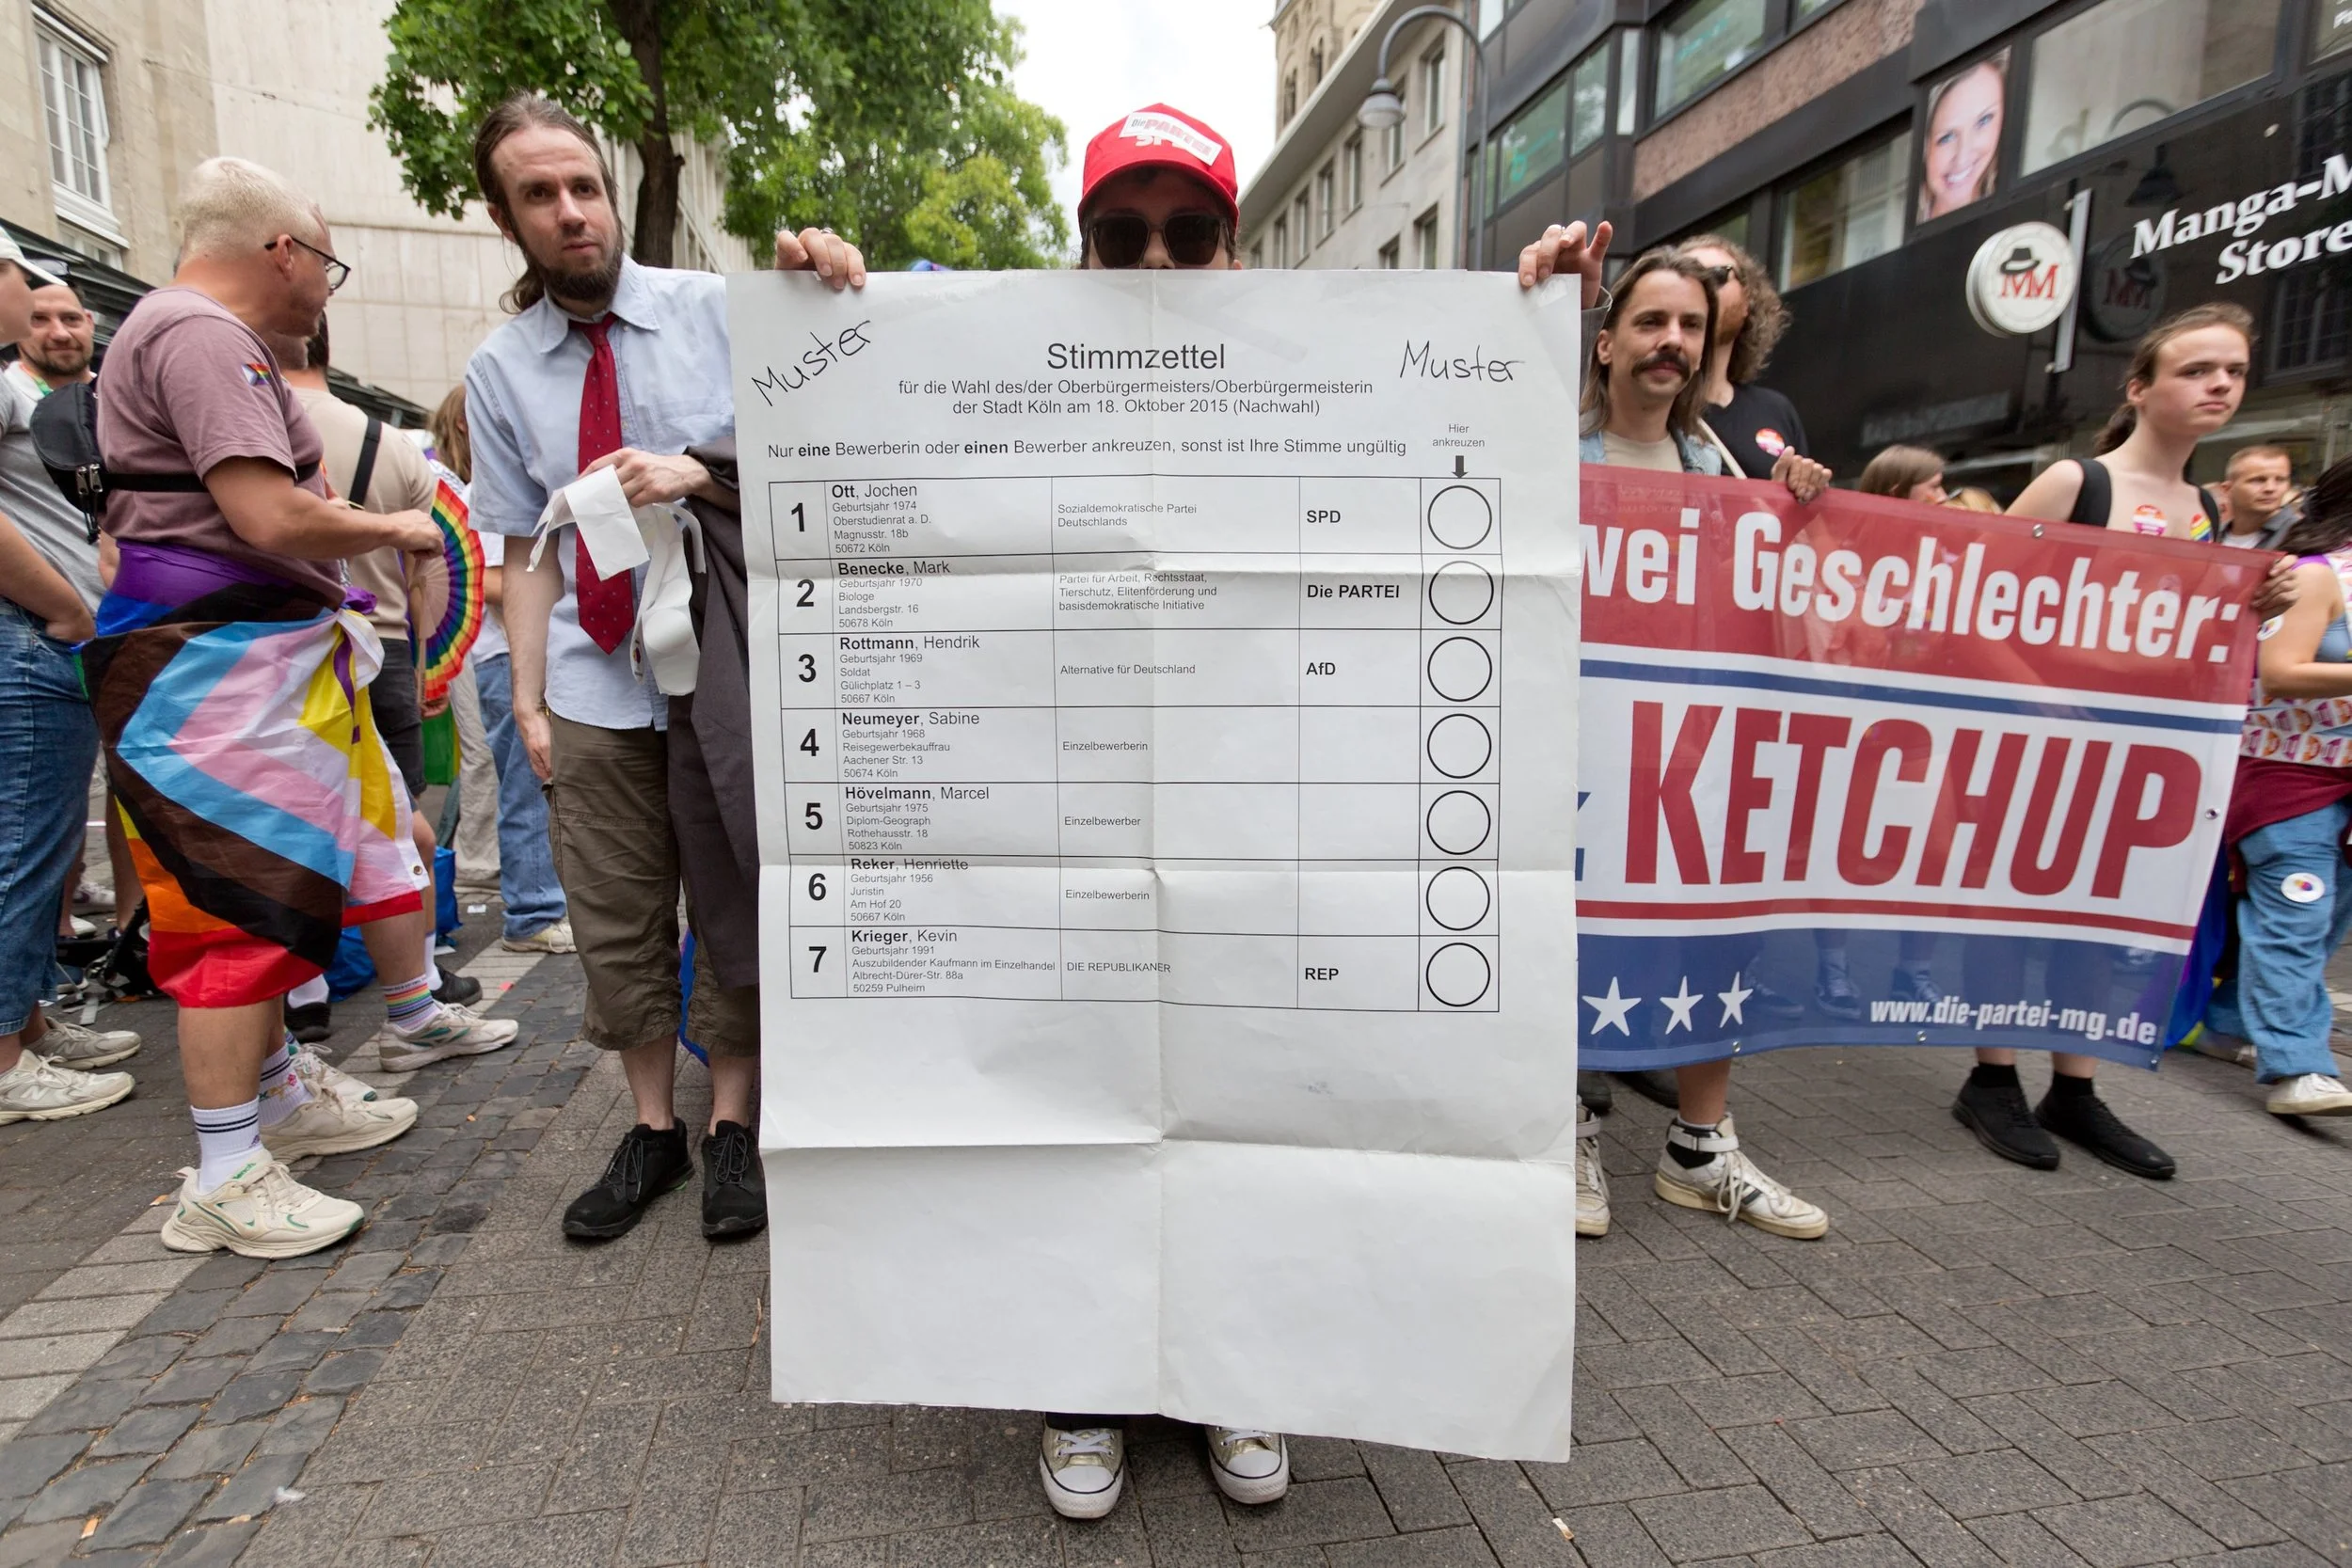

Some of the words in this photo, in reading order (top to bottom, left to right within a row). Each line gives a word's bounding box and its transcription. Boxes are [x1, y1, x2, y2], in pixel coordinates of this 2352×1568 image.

[1047, 342, 1225, 370] Stimmzettel
[1399, 340, 1526, 382] Muster
[752, 320, 871, 406] Muster
[898, 380, 919, 394] für
[924, 380, 946, 394] die
[951, 380, 990, 394] Wahl
[995, 379, 1054, 394] des/der
[1057, 379, 1373, 397] Oberbürgermeisters/Oberbürgermeisterin
[952, 400, 978, 414] der
[982, 400, 1023, 414] Stadt
[1027, 399, 1061, 414] Köln
[1067, 403, 1090, 414] am
[1097, 399, 1119, 414] 18.
[1124, 399, 1185, 413] Oktober
[1189, 399, 1228, 413] 2015
[1233, 399, 1320, 417] (Nachwahl)
[1449, 423, 1470, 433] Hier
[768, 444, 794, 458] Nur
[798, 443, 831, 457] eine
[835, 440, 920, 456] Bewerberin
[925, 440, 960, 454] oder
[963, 440, 1009, 454] einen
[1014, 439, 1088, 453] Bewerber
[1091, 438, 1176, 453] ankreuzen,
[1181, 439, 1223, 452] sonst
[1228, 438, 1245, 452] ist
[1249, 438, 1279, 452] Ihre
[1283, 438, 1342, 453] Stimme
[1347, 439, 1406, 457] ungültig
[1432, 437, 1485, 448] ankreuzen
[832, 484, 859, 500] Ott,
[864, 483, 917, 498] Jochen
[832, 501, 890, 514] Geburtsjahr
[893, 500, 916, 511] 1974
[1057, 502, 1164, 514] Sozialdemokratische
[1167, 503, 1197, 514] Partei
[790, 502, 805, 532] 1
[833, 515, 906, 527] Oberstudienrat
[908, 516, 917, 525] a.
[920, 514, 931, 524] D.
[1057, 516, 1127, 527] Deutschlands
[1306, 510, 1342, 523] SPD
[834, 530, 886, 542] Magnusstr.
[891, 529, 909, 538] 18b
[835, 543, 866, 553] 50672
[867, 543, 890, 553] Köln
[837, 561, 910, 578] Benecke,
[913, 561, 951, 575] Mark
[1059, 574, 1089, 583] Partei
[1092, 574, 1104, 583] für
[1107, 574, 1140, 583] Arbeit,
[1144, 571, 1208, 583] Rechtsstaat,
[839, 579, 896, 590] Geburtsjahr
[899, 578, 922, 587] 1970
[1733, 512, 2242, 663] Geschlechter:
[796, 578, 815, 608] 2
[1059, 587, 1114, 597] Tierschutz,
[1118, 586, 1195, 598] Elitenförderung
[1198, 586, 1217, 596] und
[1307, 584, 1333, 598] Die
[1339, 584, 1400, 598] PARTEI
[838, 592, 875, 603] Biologe
[839, 605, 903, 616] Landsbergstr.
[908, 604, 918, 613] 16
[1059, 600, 1159, 611] basisdemokratische
[1163, 600, 1204, 610] Initiative
[839, 618, 868, 628] 50678
[871, 618, 893, 627] Köln
[839, 637, 918, 651] Rottmann,
[924, 635, 980, 649] Hendrik
[839, 654, 896, 665] Geburtsjahr
[899, 653, 923, 663] 1969
[798, 653, 817, 683] 3
[840, 667, 870, 677] Soldat
[1060, 664, 1114, 674] Alternative
[1117, 664, 1131, 674] für
[1134, 664, 1196, 674] Deutschland
[1306, 662, 1336, 675] AfD
[840, 680, 894, 691] Gülichplatz
[914, 680, 921, 689] 3
[841, 693, 870, 704] 50667
[873, 694, 896, 704] Köln
[842, 712, 924, 728] Neumeyer,
[929, 711, 980, 725] Sabine
[842, 729, 898, 740] Geburtsjahr
[902, 728, 926, 738] 1968
[800, 728, 820, 757] 4
[843, 741, 950, 754] Reisegewerbekauffrau
[1063, 741, 1148, 751] Einzelbewerberin
[843, 755, 890, 765] Aachener
[892, 755, 908, 765] Str.
[912, 755, 924, 765] 13
[844, 768, 873, 778] 50674
[877, 768, 898, 778] Köln
[845, 786, 935, 801] Hövelmann,
[941, 786, 990, 800] Marcel
[1625, 701, 2201, 900] KETCHUP
[845, 802, 901, 815] Geburtsjahr
[905, 803, 929, 813] 1975
[805, 801, 823, 831] 5
[847, 816, 930, 828] Diplom-Geograph
[1064, 816, 1141, 826] Einzelbewerber
[847, 829, 913, 838] Rothehausstr.
[916, 829, 929, 838] 18
[849, 841, 879, 850] 50823
[881, 841, 902, 850] Köln
[850, 858, 899, 871] Reker,
[903, 858, 971, 870] Henriette
[850, 873, 907, 885] Geburtsjahr
[911, 873, 933, 883] 1956
[808, 873, 827, 901] 6
[850, 887, 884, 895] Juristin
[1065, 889, 1150, 900] Einzelbewerberin
[850, 899, 866, 909] Am
[869, 899, 886, 909] Hof
[889, 899, 901, 909] 20
[850, 912, 881, 922] 50667
[883, 912, 905, 922] Köln
[851, 929, 913, 945] Krieger,
[917, 929, 958, 942] Kevin
[851, 946, 909, 957] Geburtsjahr
[912, 945, 934, 955] 1991
[808, 945, 827, 974] 7
[852, 958, 928, 968] Auszubildender
[930, 958, 978, 967] Kaufmann
[980, 959, 992, 968] im
[994, 959, 1056, 971] Einzelhandel
[1067, 961, 1085, 971] DIE
[1088, 962, 1170, 973] REPUBLIKANER
[852, 971, 943, 980] Albrecht-Dürer-Str.
[946, 971, 963, 980] 88a
[1305, 967, 1340, 981] REP
[853, 983, 883, 993] 50259
[886, 984, 926, 992] Pulheim
[1870, 996, 2157, 1045] www.die-partei-mg.de
